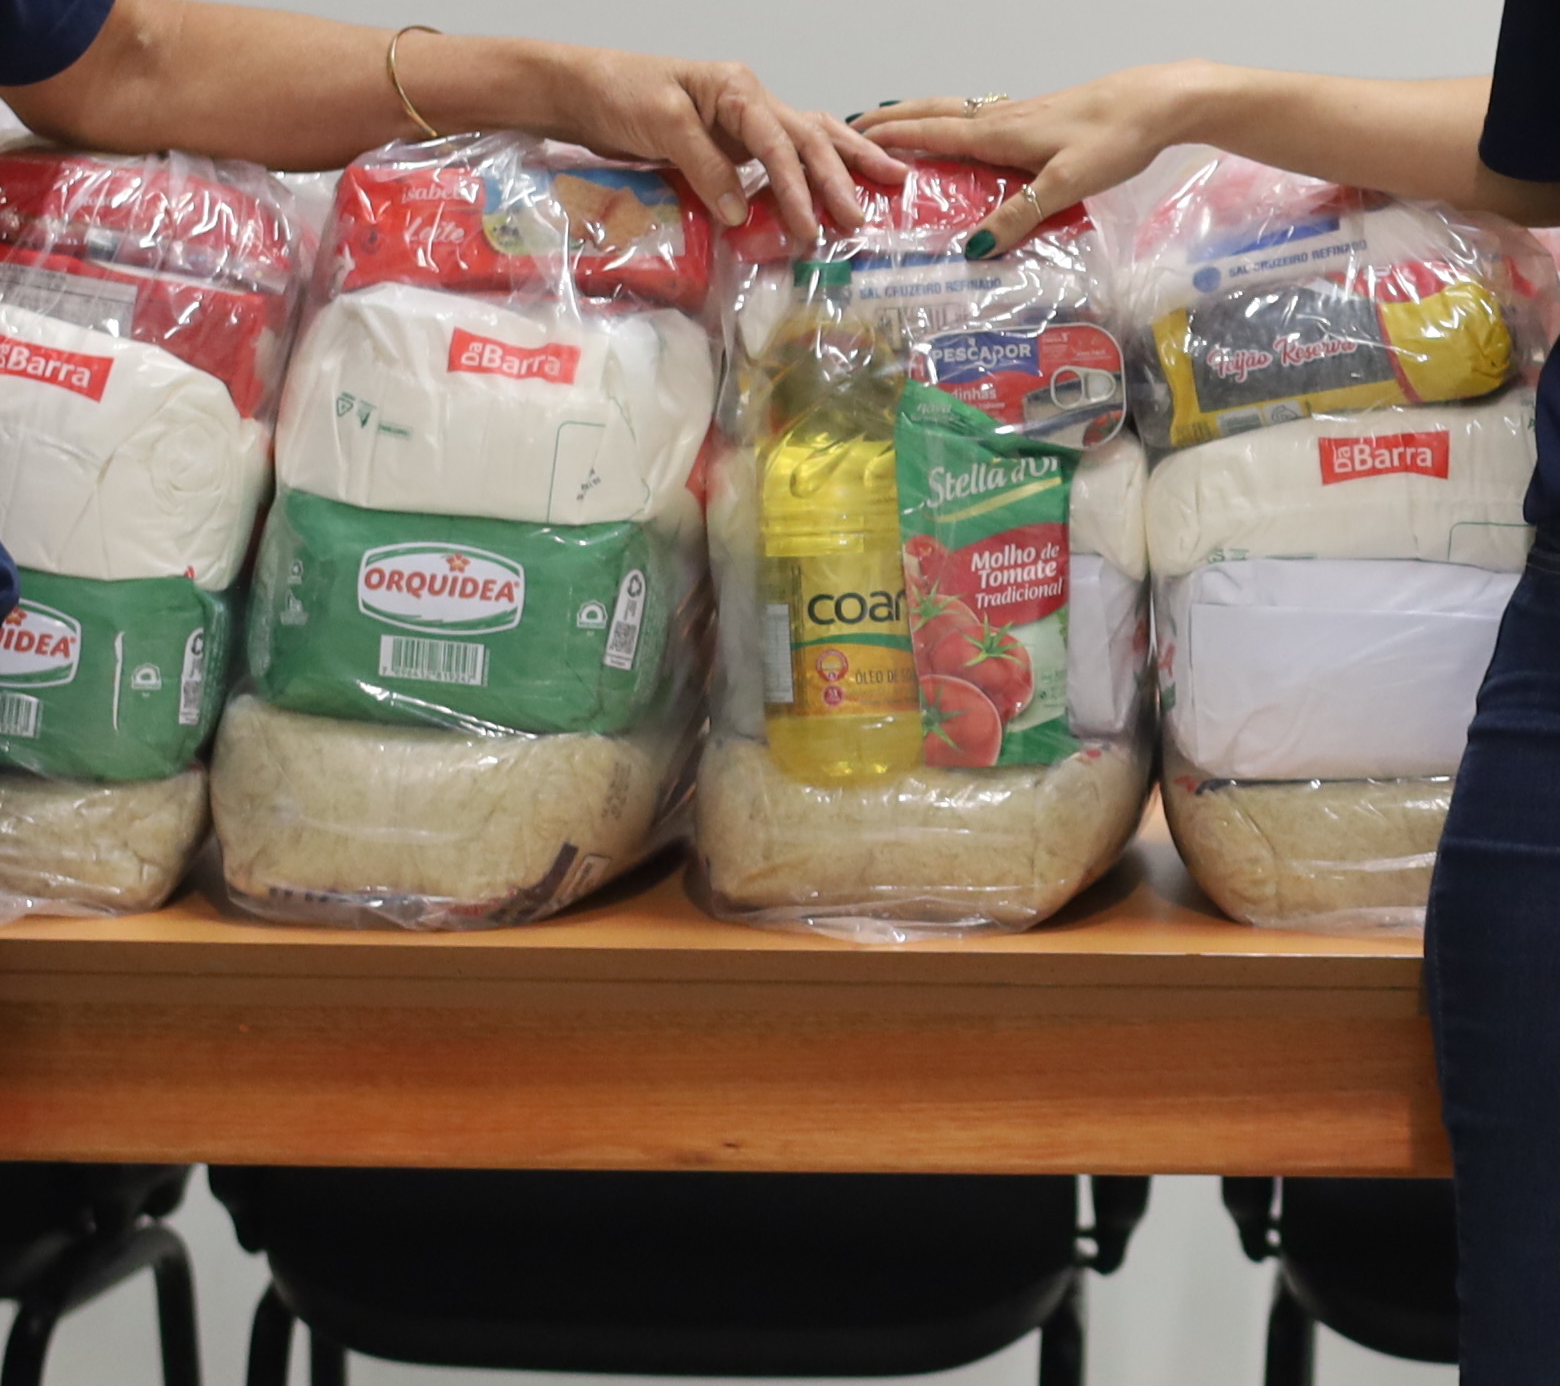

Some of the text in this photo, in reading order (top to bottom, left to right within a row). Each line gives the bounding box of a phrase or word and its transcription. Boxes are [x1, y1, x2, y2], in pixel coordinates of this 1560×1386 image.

[7, 346, 91, 389] Barra
[482, 344, 561, 376] Barra
[933, 343, 1032, 363] PESCADOR
[951, 387, 997, 400] dinhas
[1353, 445, 1433, 471] Barra
[927, 463, 1006, 508] Stella
[971, 542, 1060, 572] Molho de
[364, 567, 516, 603] ORQUIDEA
[978, 560, 1057, 589] Tomate
[807, 589, 906, 625] coa
[975, 578, 1064, 609] Tradicional
